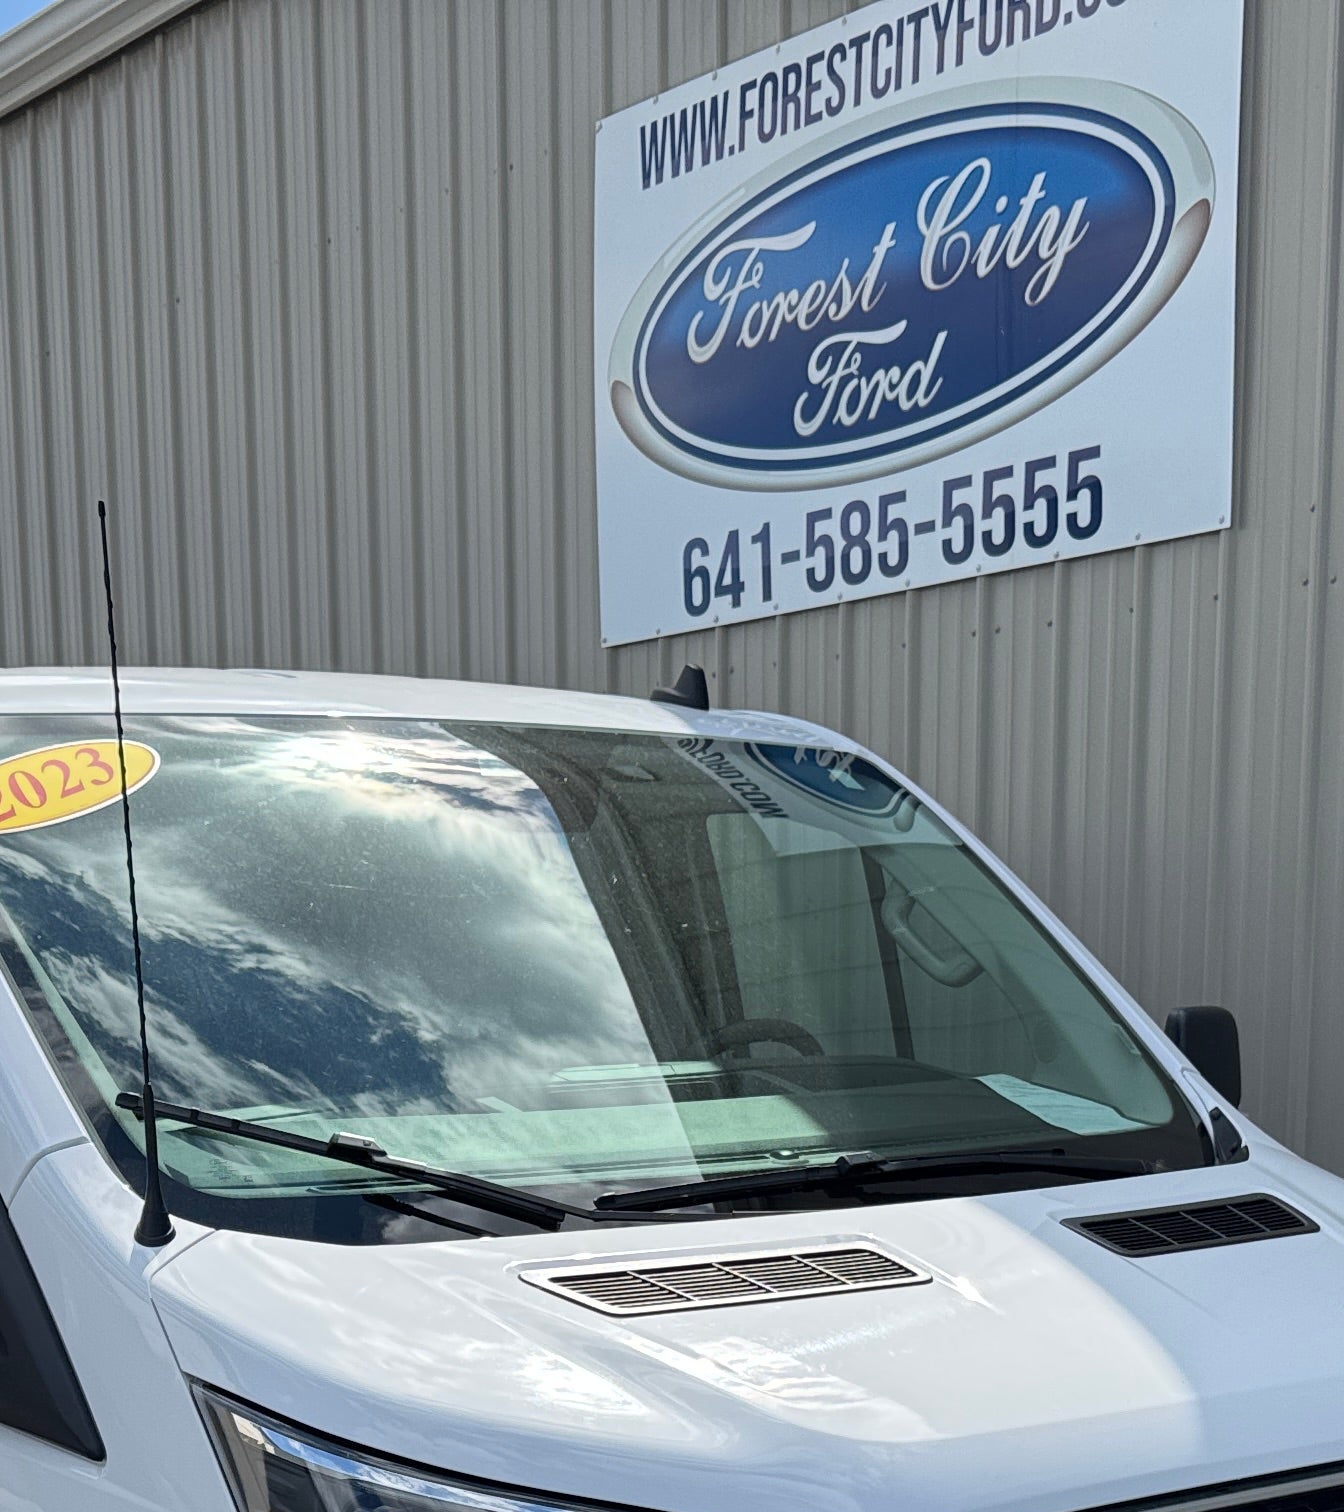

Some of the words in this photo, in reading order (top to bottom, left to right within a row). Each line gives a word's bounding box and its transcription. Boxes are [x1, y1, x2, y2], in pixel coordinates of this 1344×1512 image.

[639, 0, 1128, 191] WWW.FORESTCITYFOR.
[686, 220, 897, 364] Forest
[916, 156, 1090, 306] City
[793, 319, 948, 437] Ford
[682, 445, 1104, 617] 641-585-5555
